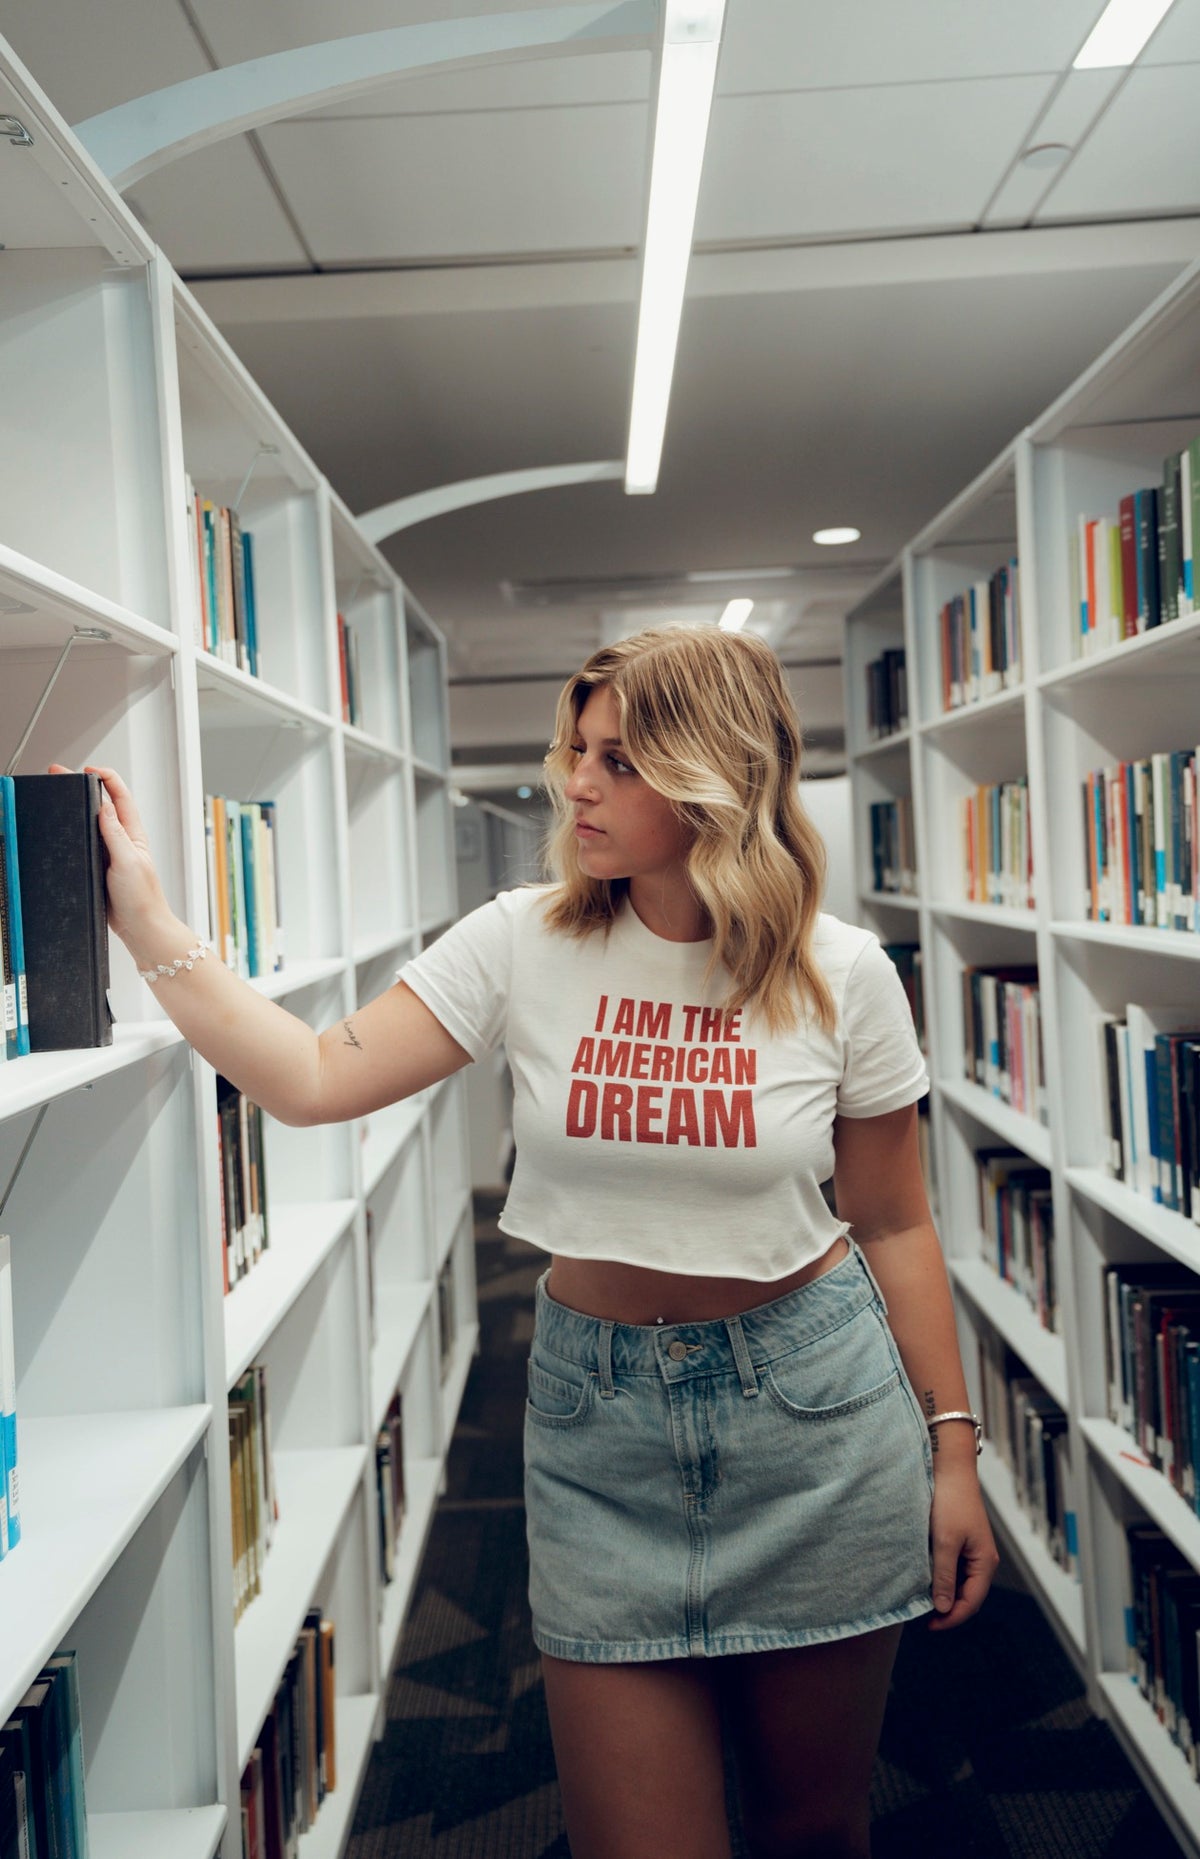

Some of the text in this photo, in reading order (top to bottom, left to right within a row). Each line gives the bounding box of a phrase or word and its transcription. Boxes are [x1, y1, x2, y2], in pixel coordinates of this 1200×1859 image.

[595, 995, 743, 1043] I AM THE
[571, 1037, 757, 1085] AMERICAN
[566, 1079, 758, 1148] DREAM
